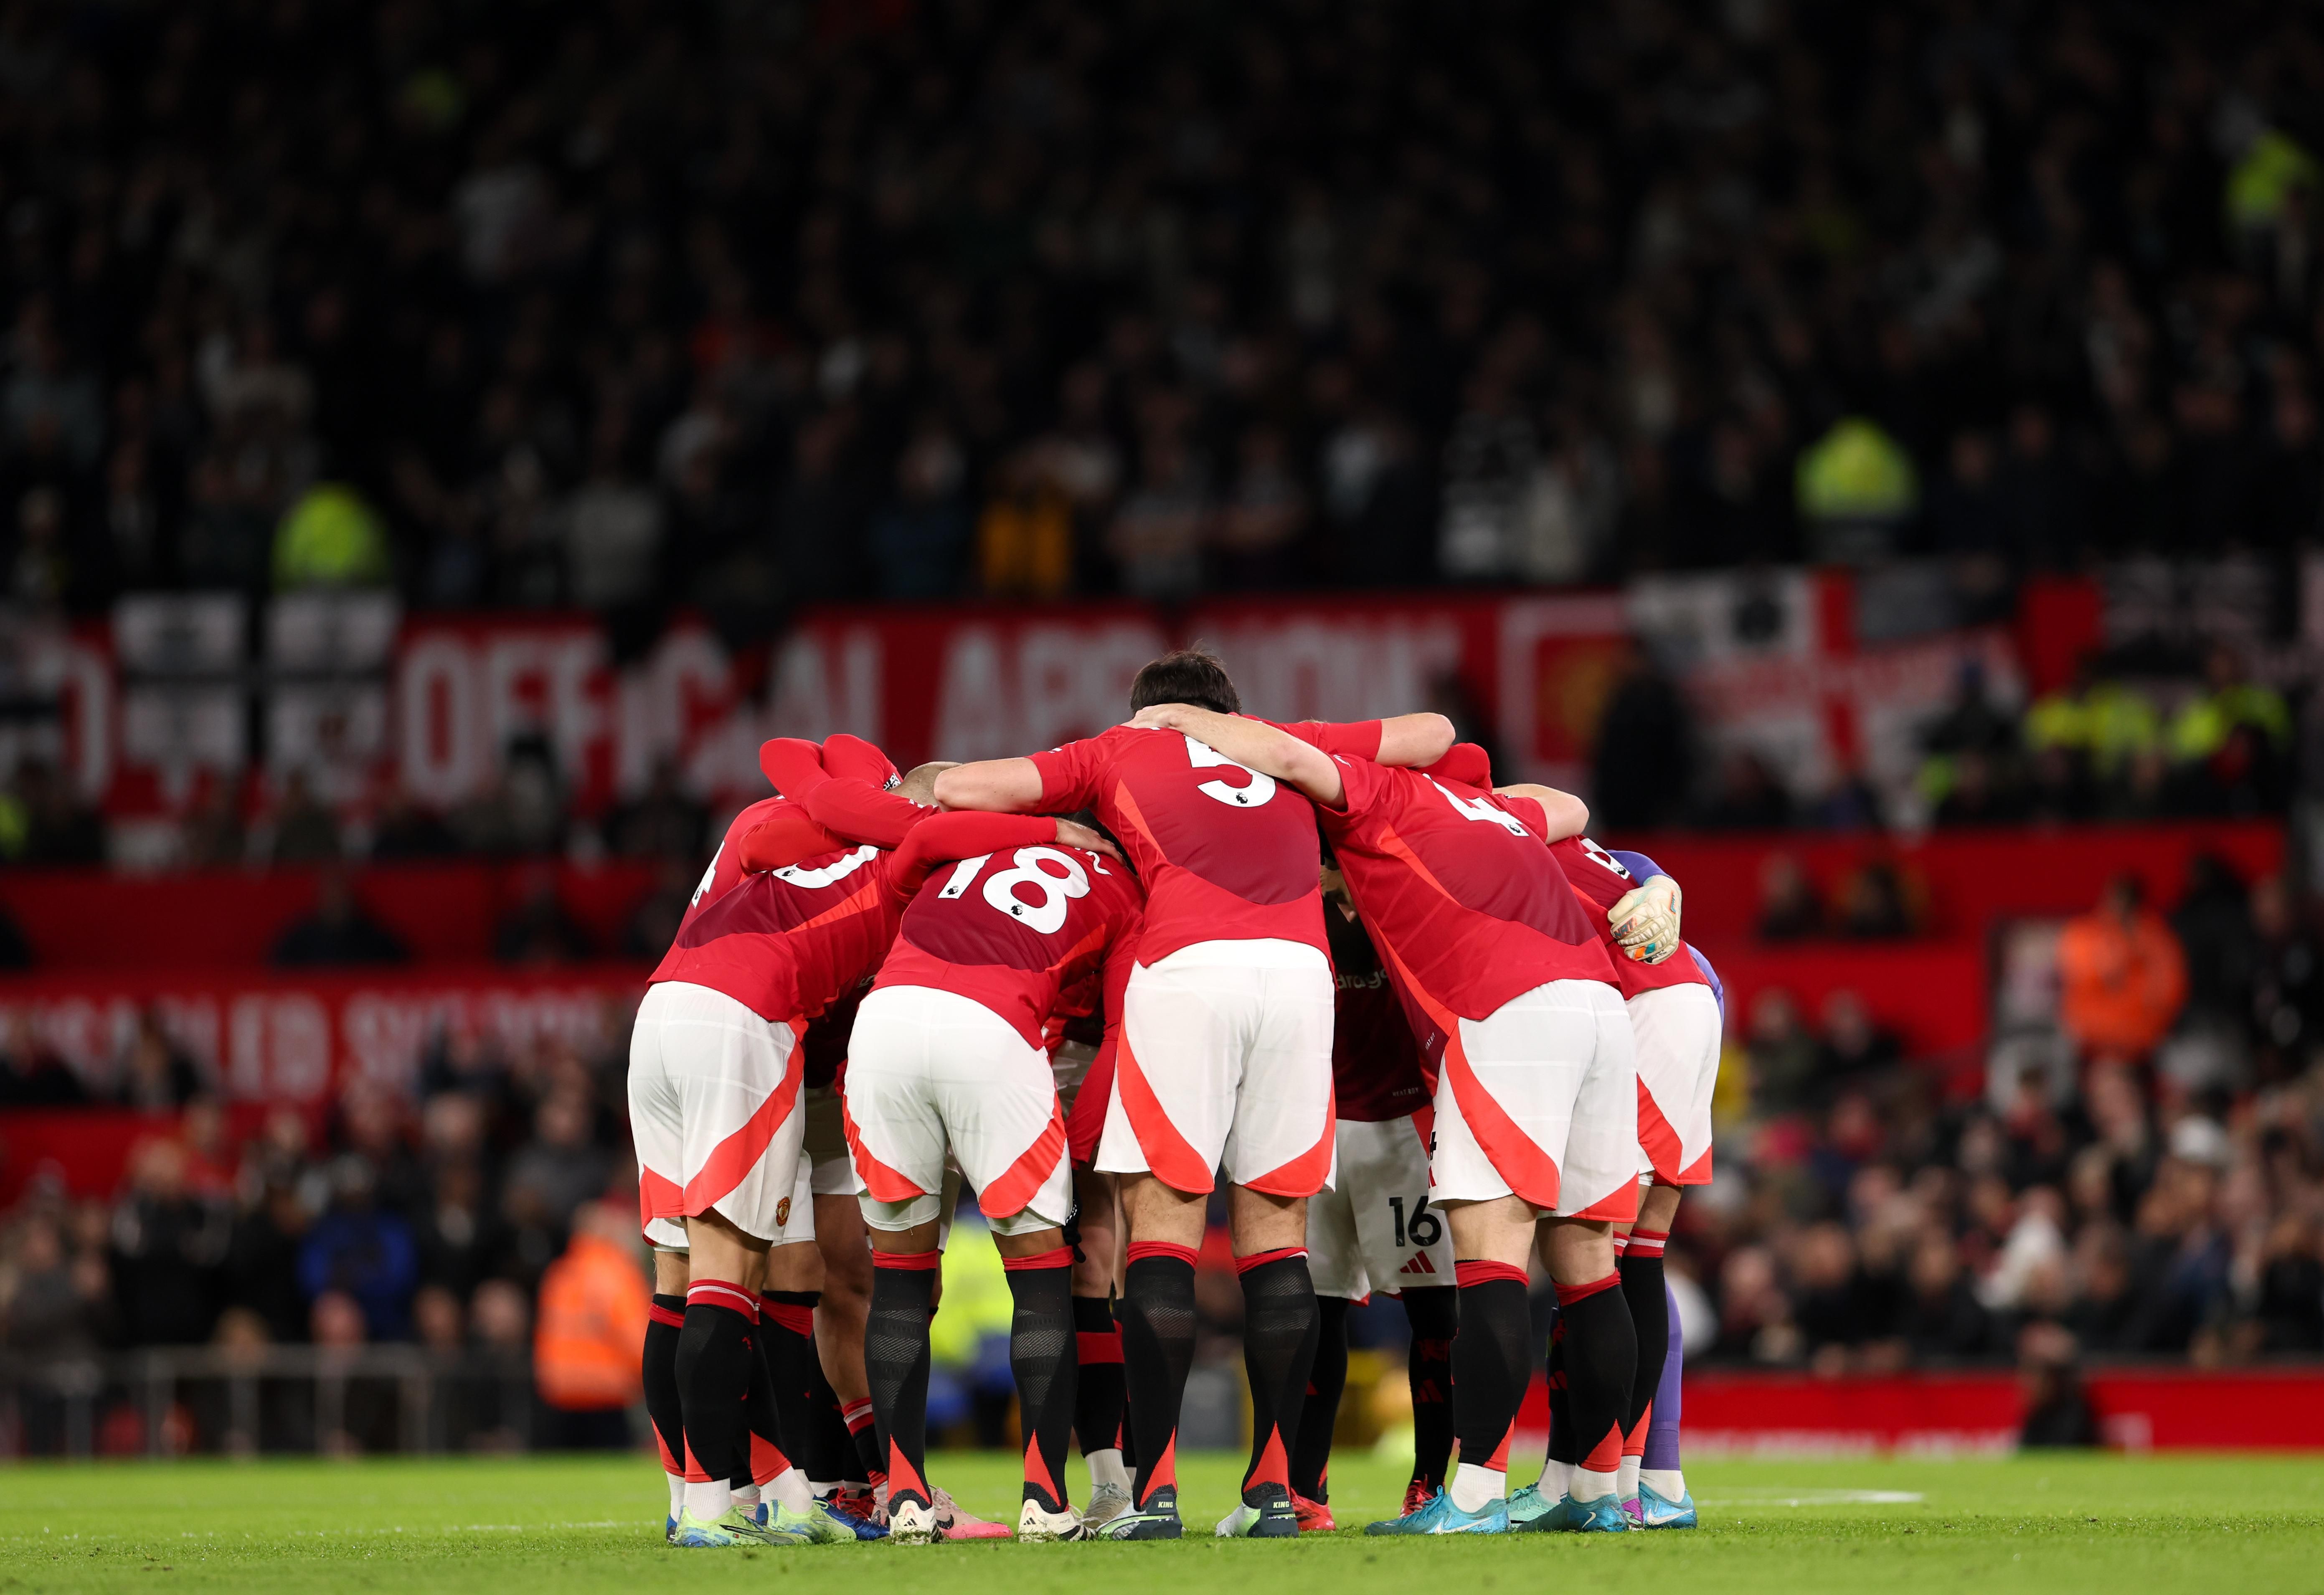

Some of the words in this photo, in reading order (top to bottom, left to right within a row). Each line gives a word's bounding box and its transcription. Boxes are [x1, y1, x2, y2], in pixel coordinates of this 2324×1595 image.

[1183, 734, 1276, 808] 5
[1422, 773, 1530, 837] 4
[937, 846, 1091, 934] 18
[1389, 1196, 1441, 1247] 16
